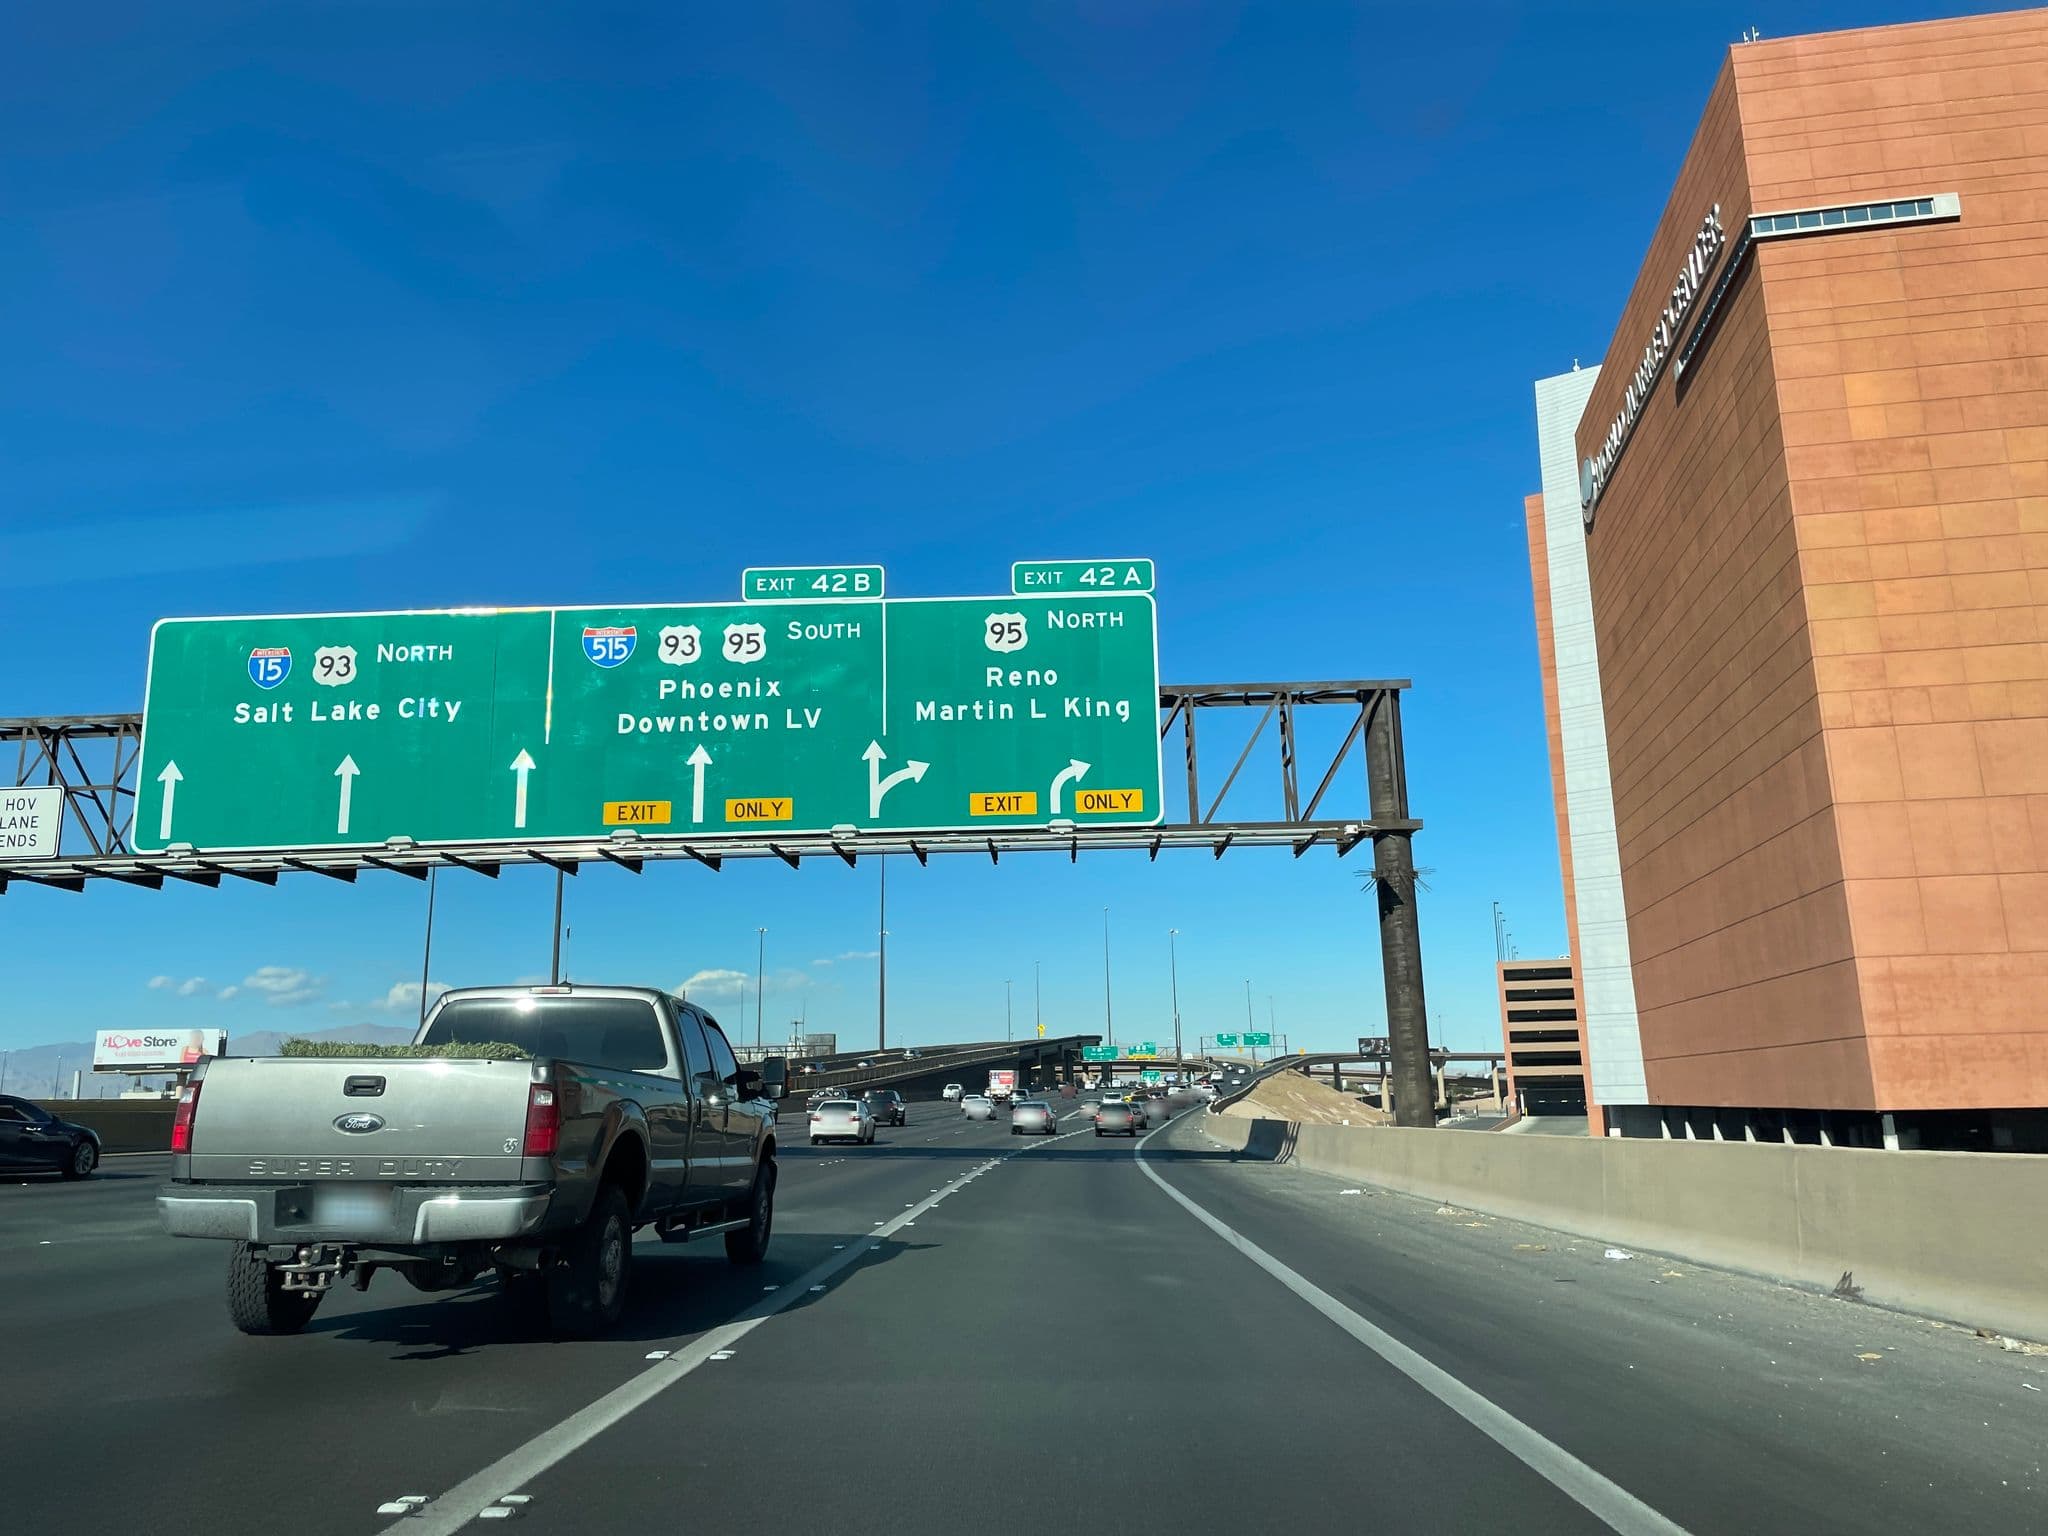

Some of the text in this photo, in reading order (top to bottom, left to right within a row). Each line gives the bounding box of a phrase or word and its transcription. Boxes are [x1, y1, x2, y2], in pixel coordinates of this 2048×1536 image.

[756, 577, 795, 592] EXIT
[1024, 571, 1063, 585] EXIT
[1047, 610, 1124, 629] NORTH
[787, 621, 861, 640] SOUTH
[989, 621, 1022, 644] 95
[377, 643, 453, 663] NORTH
[592, 637, 629, 660] 515
[664, 634, 696, 657] 93
[728, 632, 761, 655] 95
[258, 658, 283, 681] 15
[319, 655, 351, 677] 93
[986, 666, 1058, 687] Reno
[659, 677, 781, 700] Phoenix
[233, 696, 462, 724] Salt Lake City
[915, 697, 1130, 723] Martin L King
[617, 707, 822, 734] Downtown LV
[5, 798, 37, 811] HOV
[734, 801, 783, 818] ONLY
[984, 795, 1023, 812] EXIT
[1083, 793, 1133, 810] ONLY
[617, 804, 657, 821] EXIT
[0, 815, 39, 830] LANE
[0, 833, 37, 848] ENDS
[143, 1036, 178, 1048] Store
[344, 1116, 371, 1129] Ford
[249, 1159, 463, 1176] SUPER DUTY
